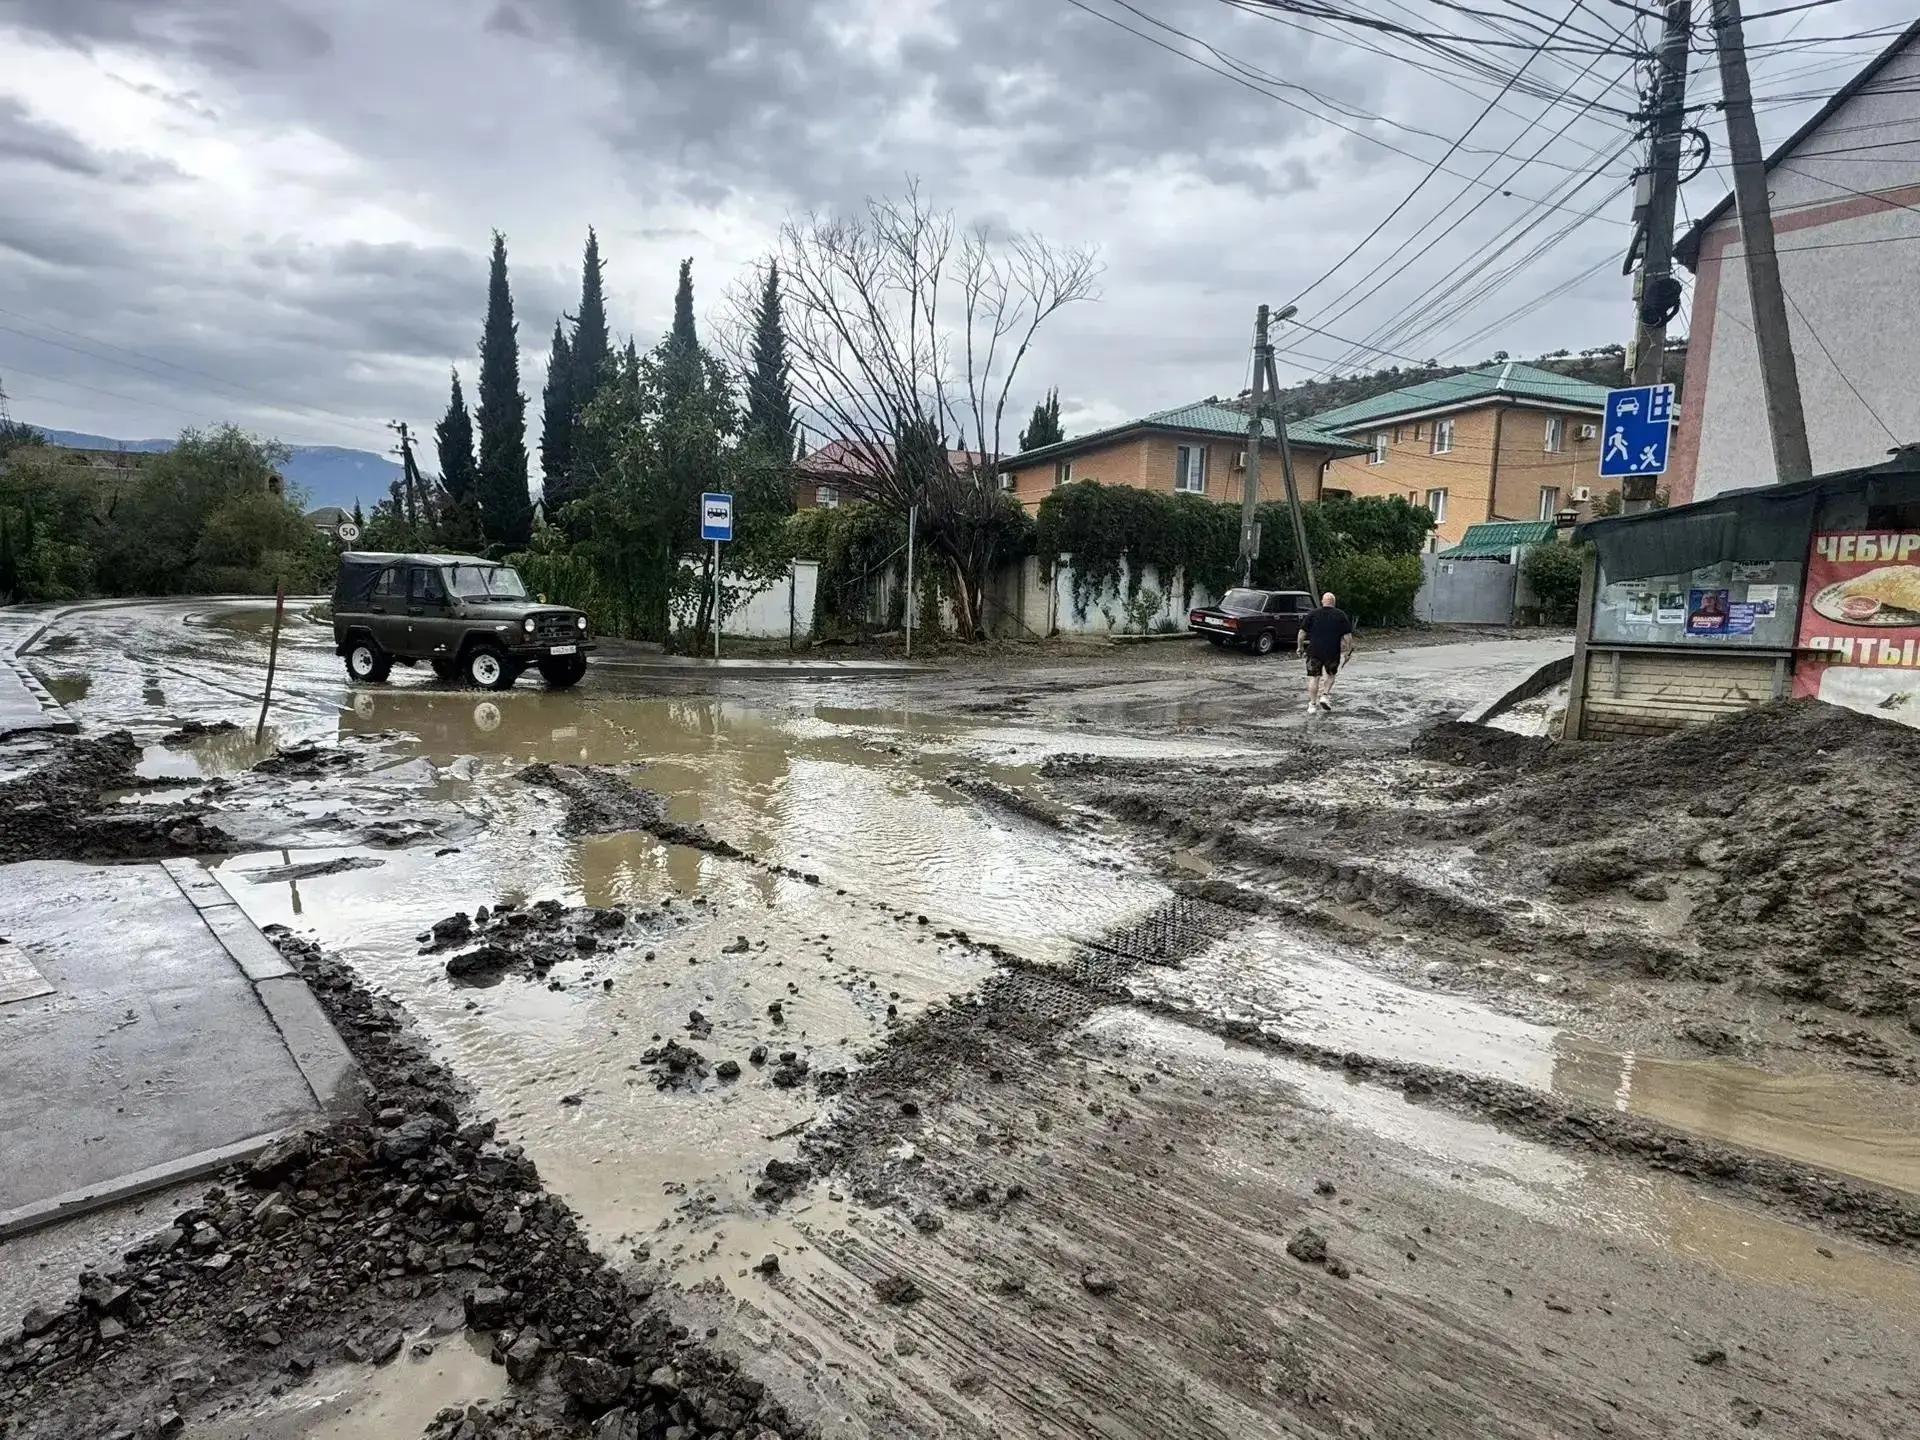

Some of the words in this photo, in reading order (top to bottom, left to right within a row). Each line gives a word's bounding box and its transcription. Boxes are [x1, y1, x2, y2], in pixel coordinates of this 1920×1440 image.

[342, 527, 355, 536] 50
[1816, 534, 1920, 562] ЧЕБУР
[1808, 636, 1920, 666] ЯНТЫ
